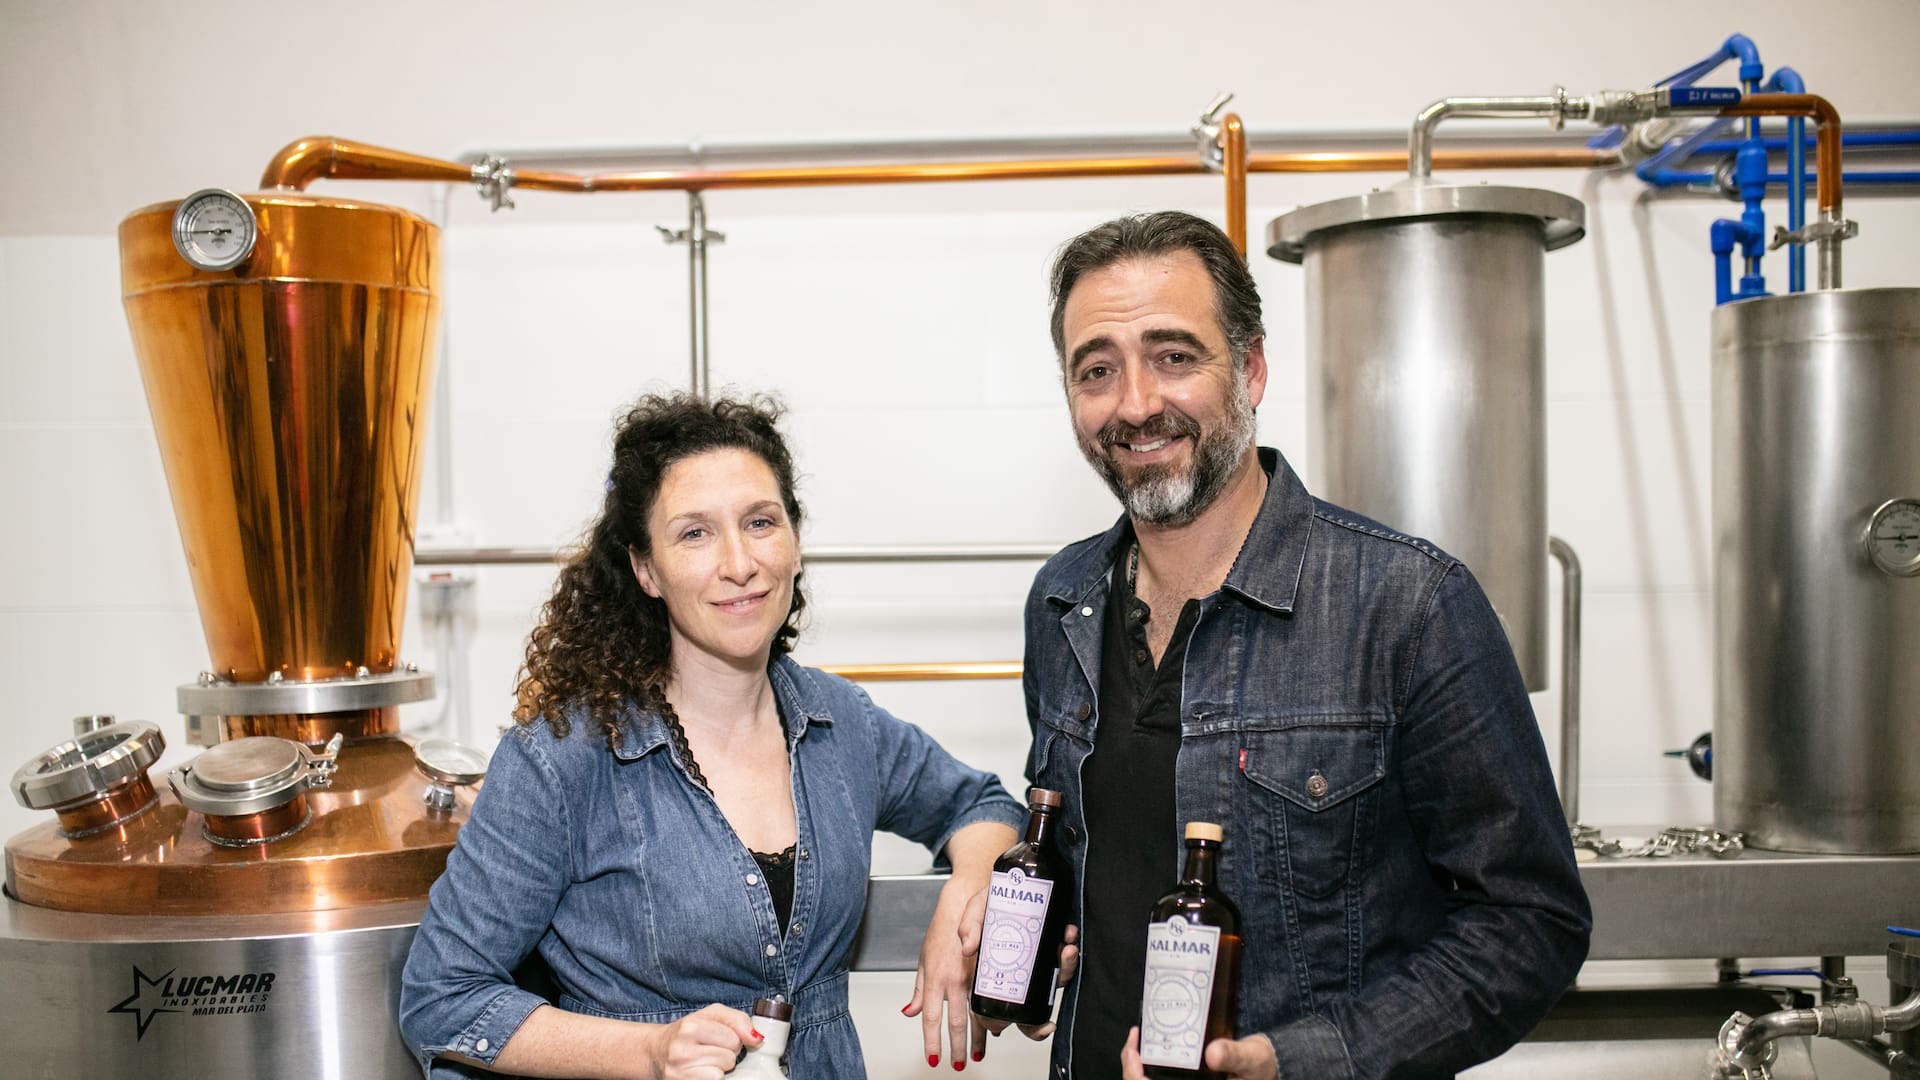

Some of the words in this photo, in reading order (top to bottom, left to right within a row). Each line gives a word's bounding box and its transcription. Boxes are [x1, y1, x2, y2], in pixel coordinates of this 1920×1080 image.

[991, 885, 1044, 904] KALMAR
[1150, 939, 1211, 956] KALMAR
[161, 973, 276, 997] LUCMAR
[163, 994, 269, 1007] INOXIDABLES
[192, 1008, 216, 1016] MAR
[217, 1006, 234, 1015] DEL
[237, 1004, 266, 1014] PLATA
